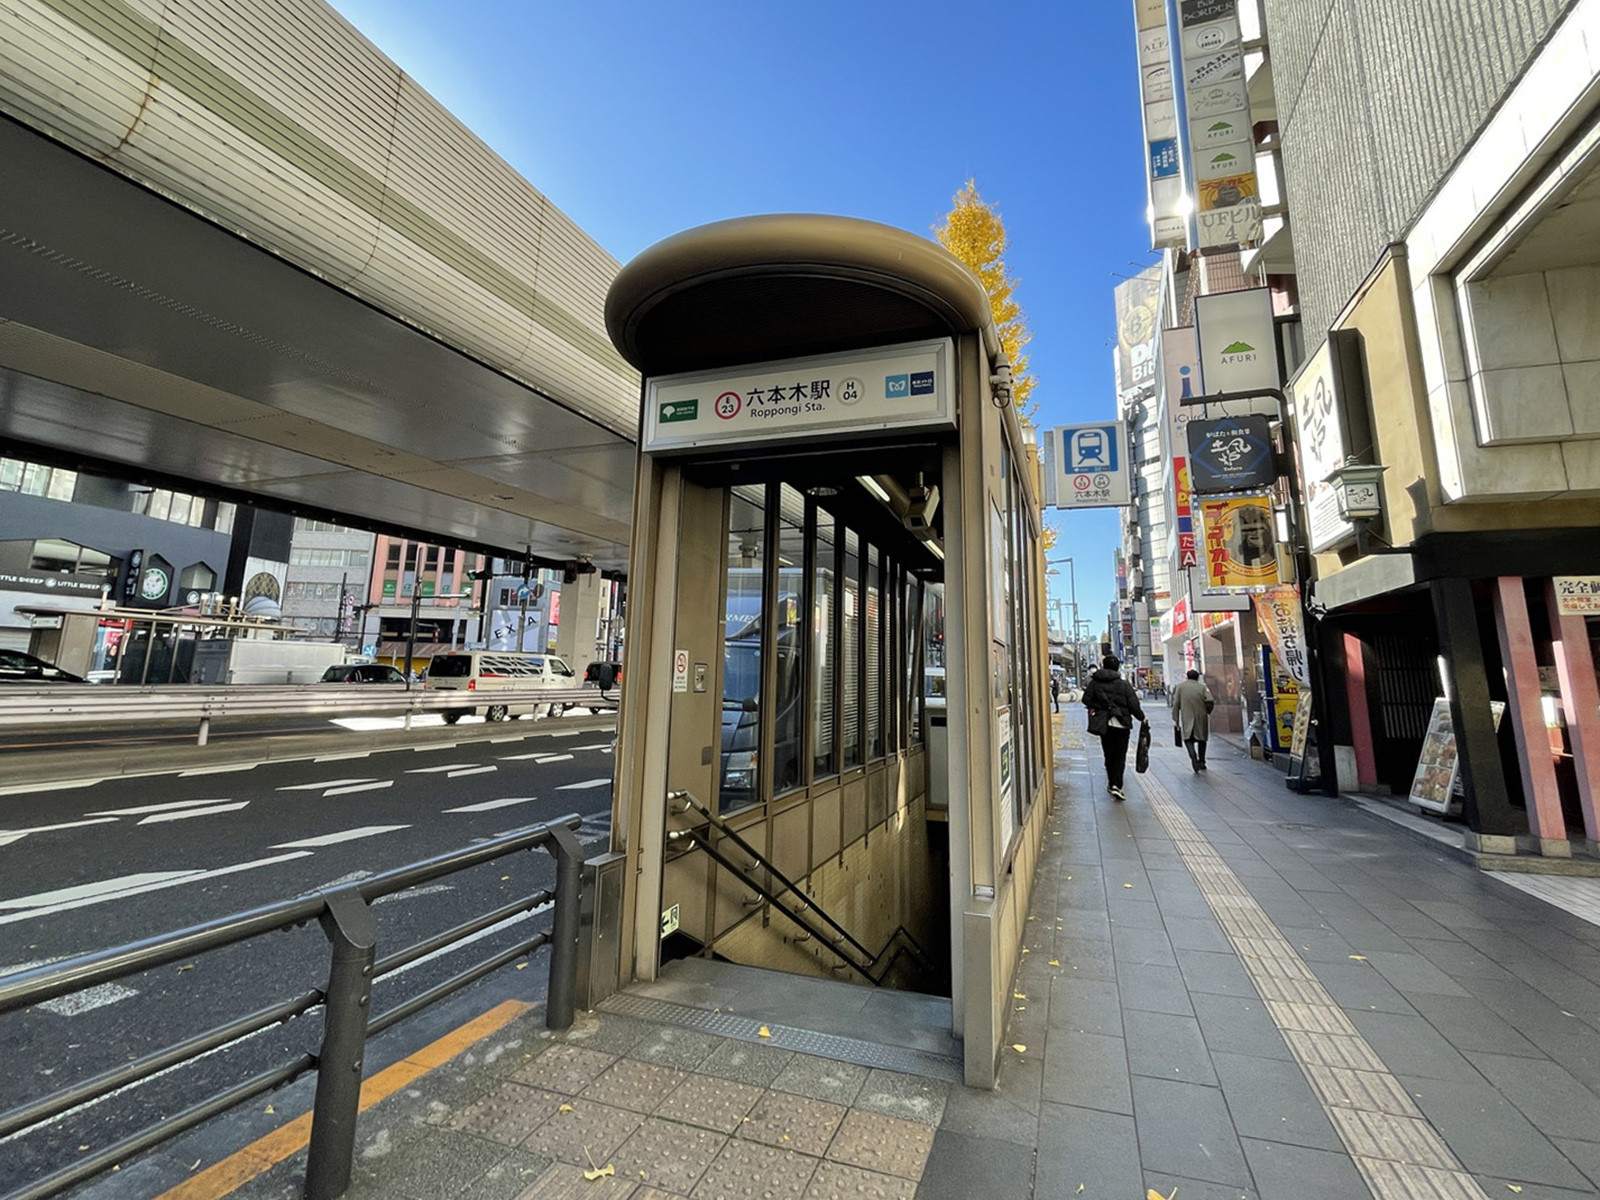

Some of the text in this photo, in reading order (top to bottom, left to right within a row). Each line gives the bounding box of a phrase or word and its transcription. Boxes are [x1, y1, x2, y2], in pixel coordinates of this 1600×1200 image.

[1196, 53, 1226, 74] BAR
[1207, 130, 1234, 138] AFURI
[1211, 161, 1237, 170] AFURI
[1221, 354, 1257, 364] AFURI
[846, 381, 854, 390] H
[746, 380, 830, 407] 六本木駅
[842, 390, 858, 401] 04
[721, 404, 735, 414] 23
[750, 402, 826, 418] Roppongi Sta.
[1075, 489, 1111, 498] 六本木駅
